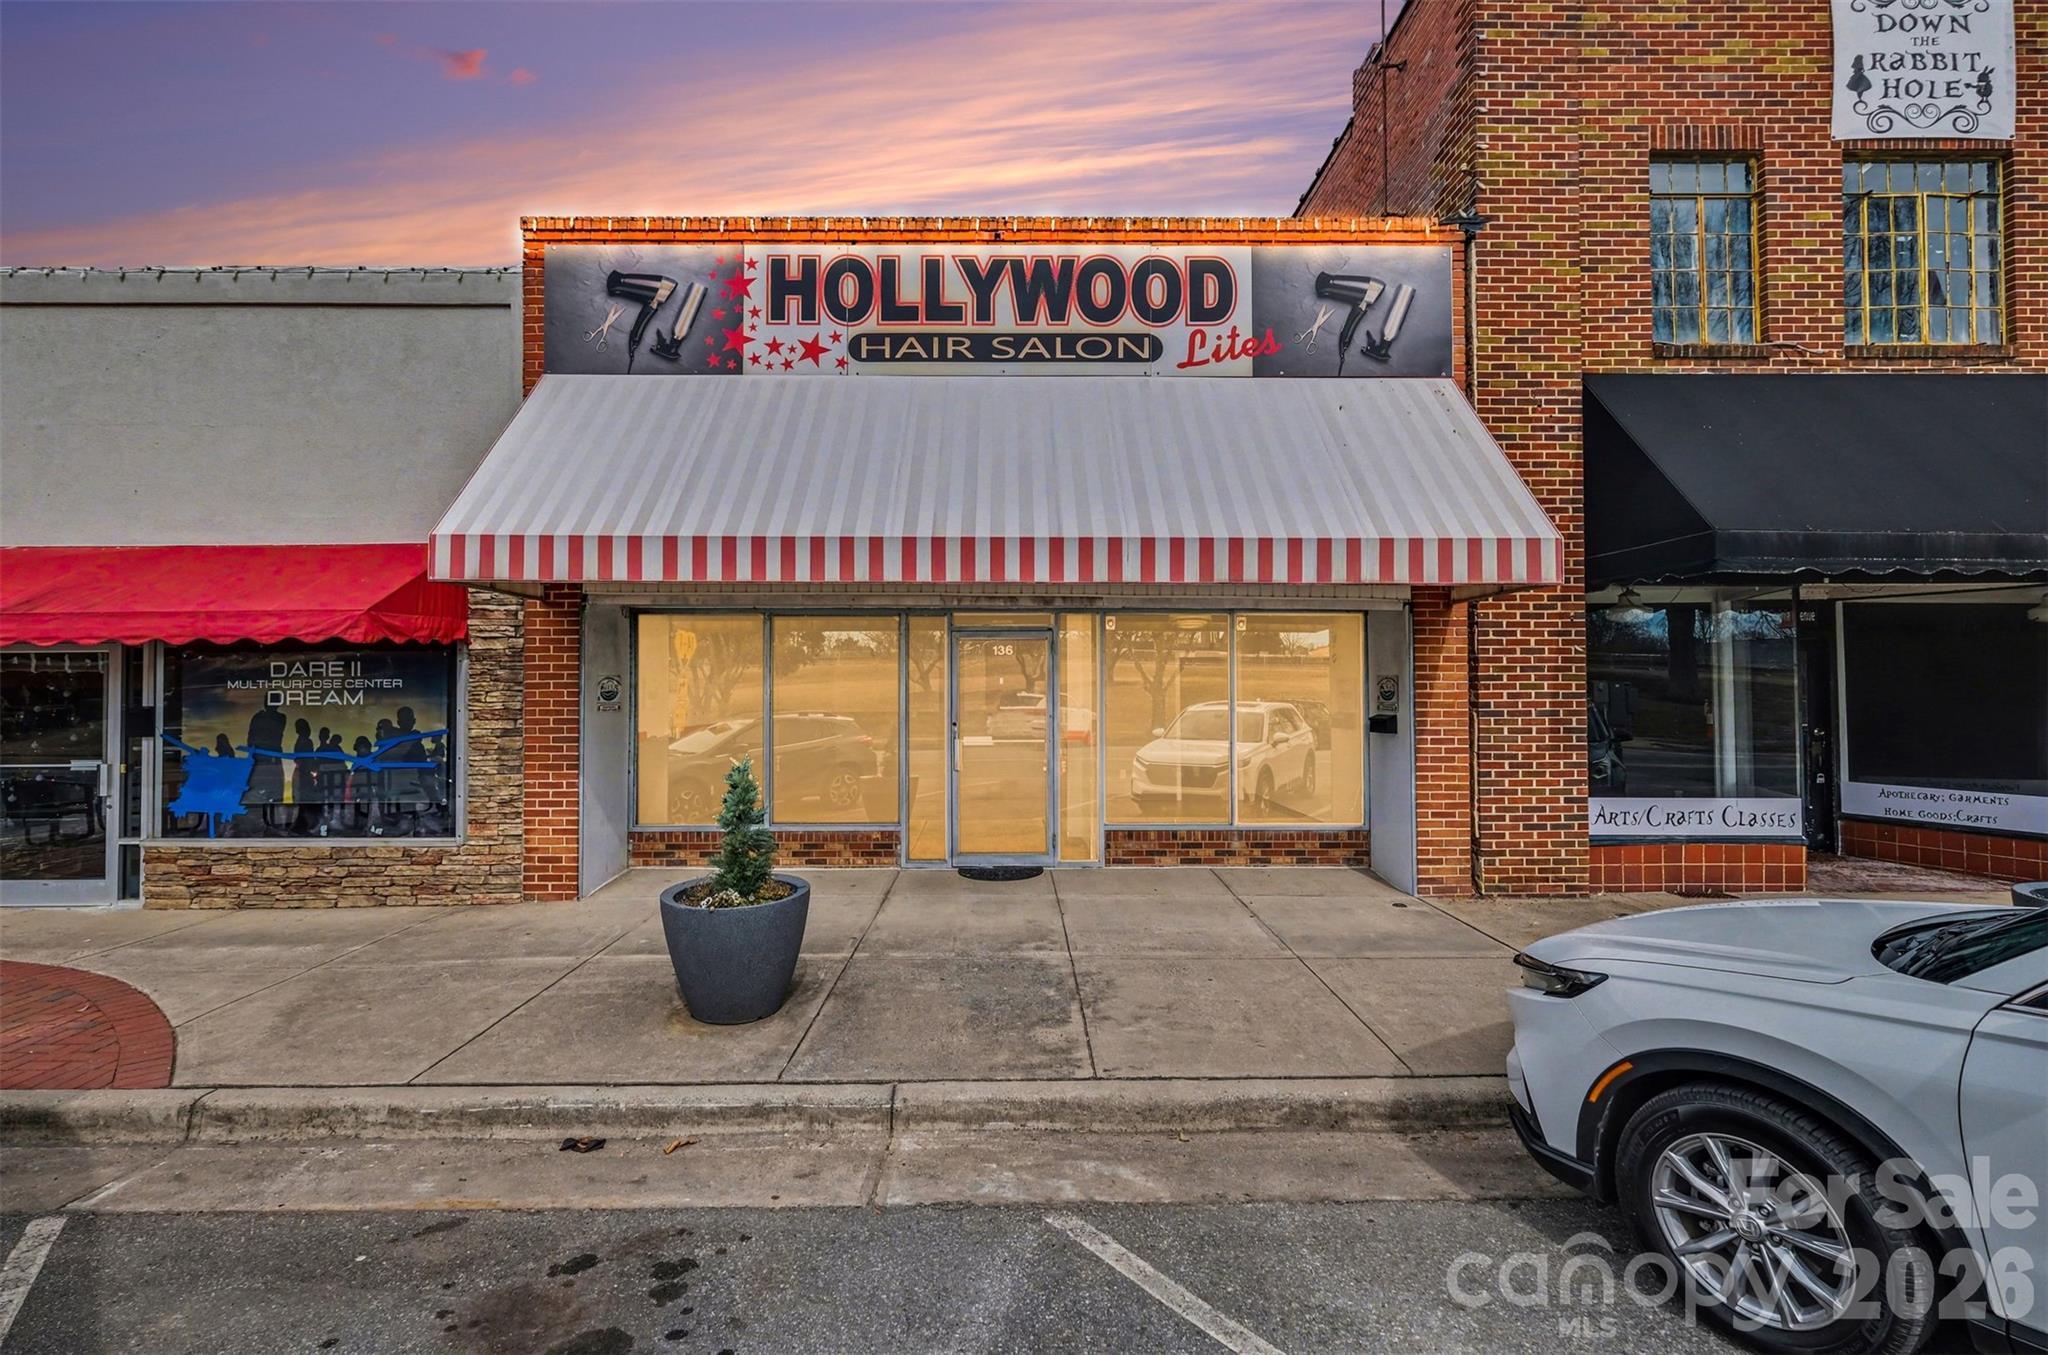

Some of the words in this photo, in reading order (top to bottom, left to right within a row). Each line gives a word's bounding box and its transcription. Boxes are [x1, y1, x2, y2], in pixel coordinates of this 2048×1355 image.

[1872, 13, 1973, 34] DOWN
[1910, 36, 1940, 47] THE
[1879, 77, 1965, 100] HOLE
[766, 254, 1238, 328] HOLLYWOOD
[860, 336, 974, 360] HAIR
[990, 336, 1150, 360] SALON
[1176, 326, 1282, 369] Lites
[992, 645, 1014, 656] 136
[270, 661, 345, 677] DARE
[351, 661, 361, 677] II
[227, 679, 342, 689] MULTI-PURPOSE
[344, 679, 403, 688] CENTER
[267, 690, 364, 706] DREAM
[1884, 807, 1913, 818] HOME
